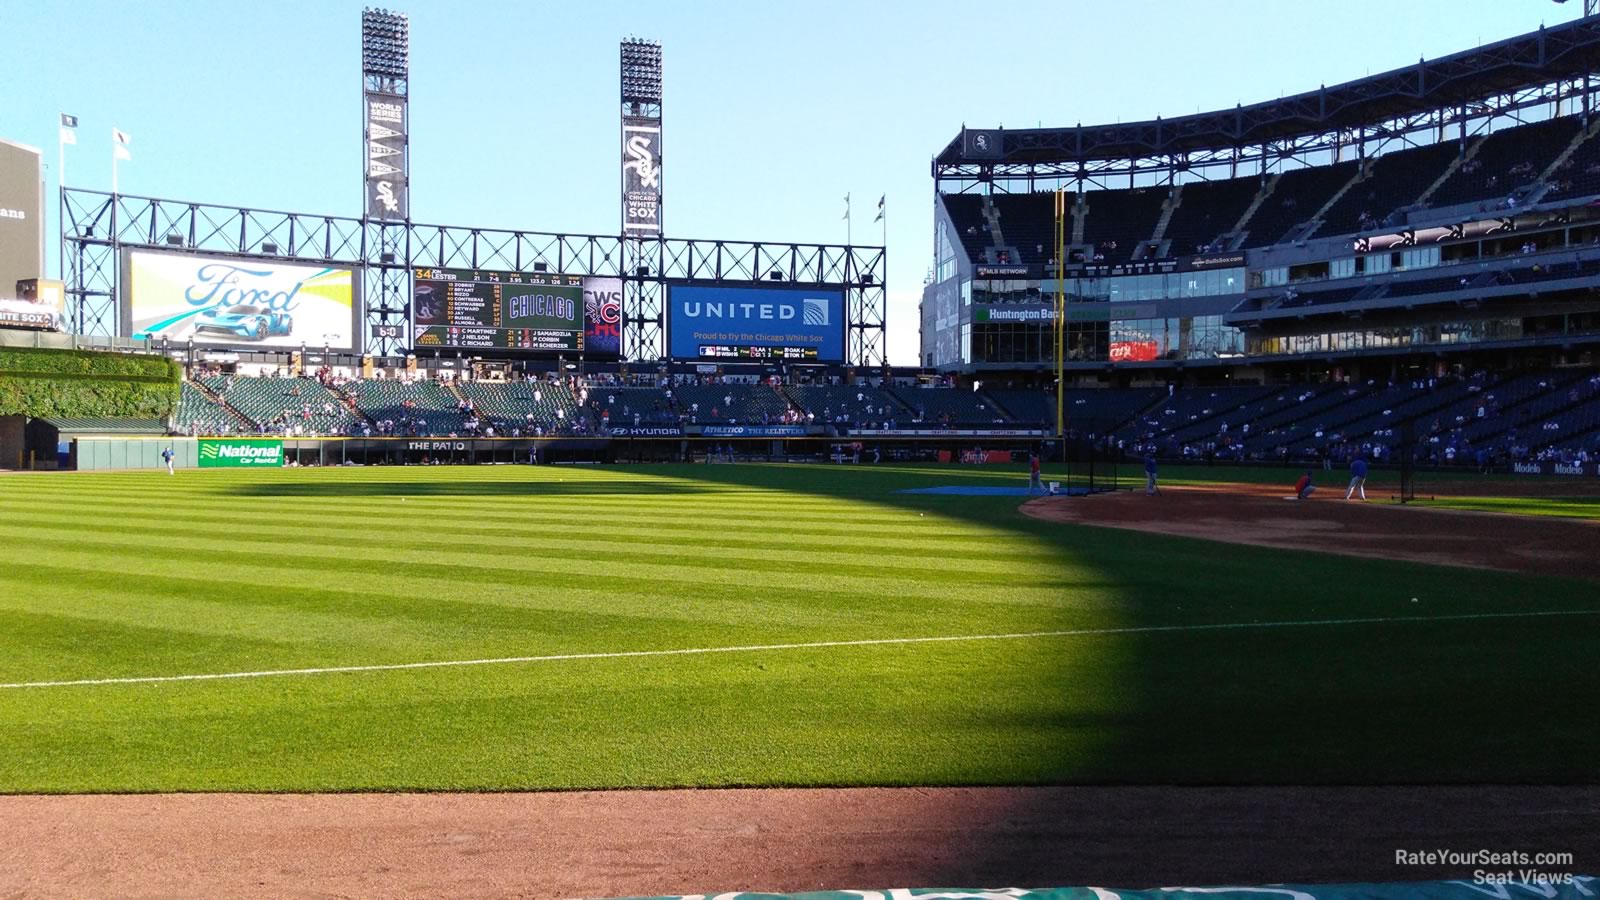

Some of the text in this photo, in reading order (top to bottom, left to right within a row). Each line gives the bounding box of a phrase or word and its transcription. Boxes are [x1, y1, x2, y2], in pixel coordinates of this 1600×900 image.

[371, 101, 402, 112] WORLD
[371, 108, 402, 119] SERIES
[629, 207, 657, 218] SOX
[415, 269, 431, 279] 34
[185, 264, 303, 312] Ford
[509, 294, 575, 321] CHICAGO
[684, 301, 796, 320] UNITED
[21, 313, 43, 323] SOX
[989, 309, 1040, 321] Huntington
[693, 331, 824, 343] Proud to fly the Chicago White Sox
[630, 428, 680, 436] HYUNDAI
[704, 426, 744, 434] ATHLETICO
[218, 443, 281, 457] National
[408, 441, 465, 451] THE PATIO
[1514, 462, 1541, 473] Modelo
[1554, 463, 1583, 474] Modelo
